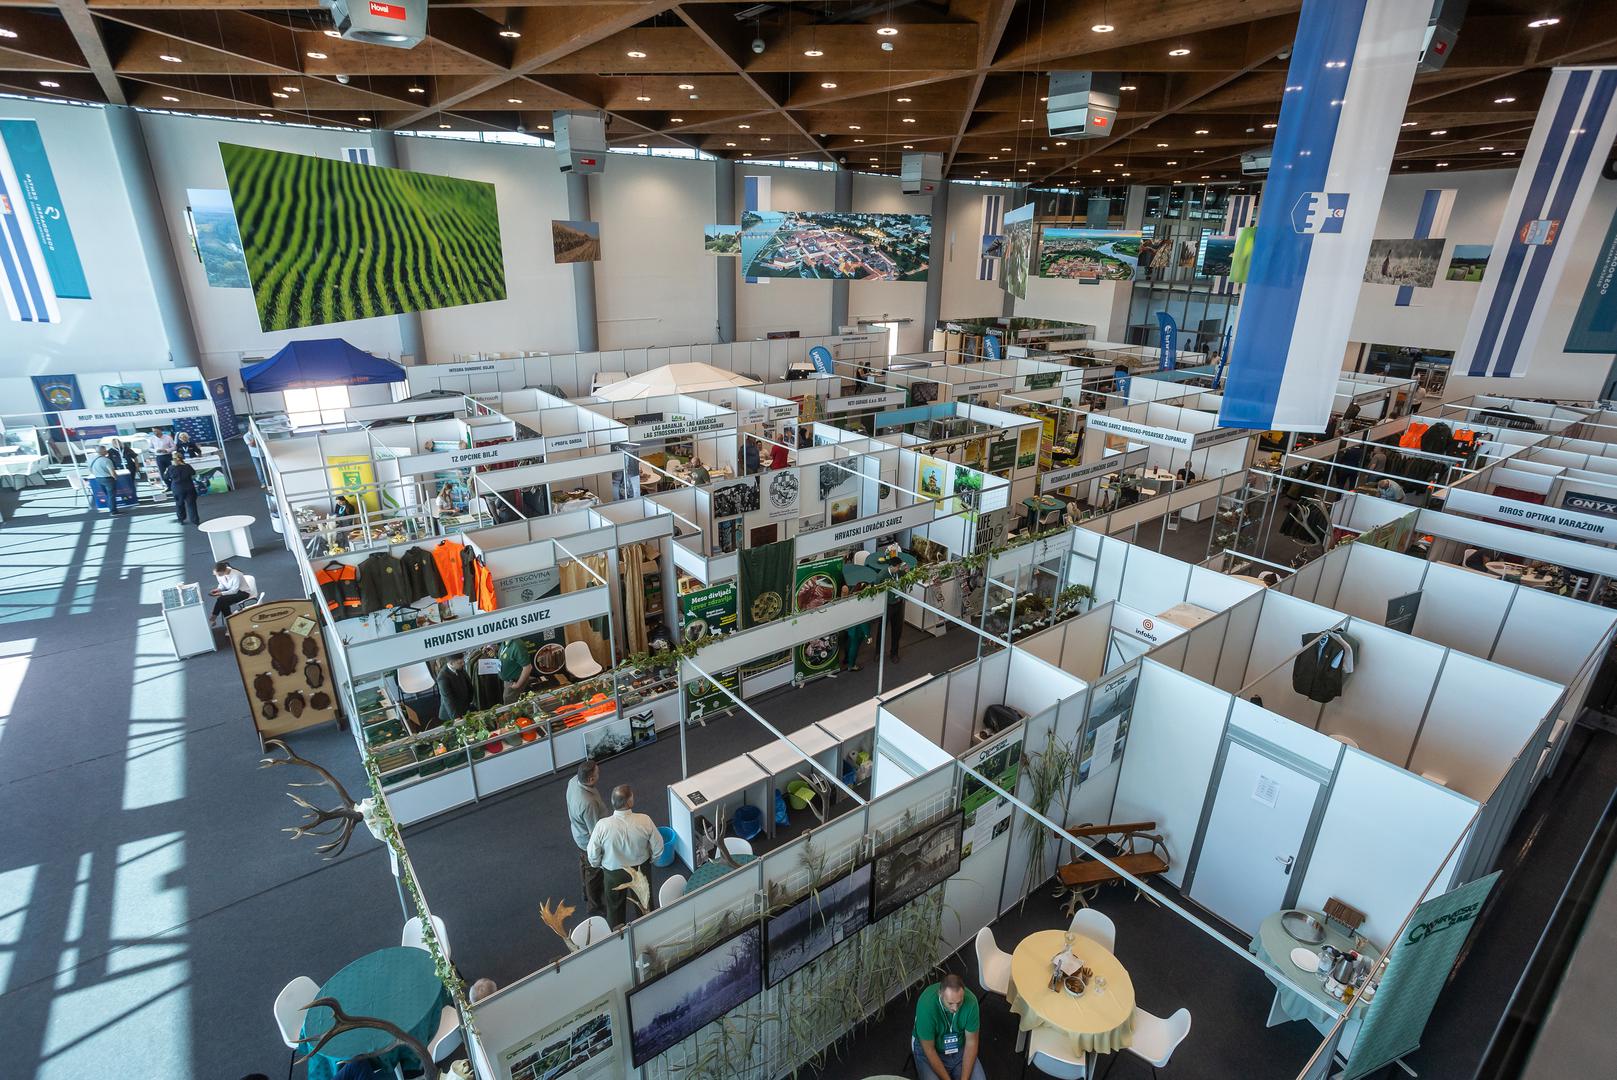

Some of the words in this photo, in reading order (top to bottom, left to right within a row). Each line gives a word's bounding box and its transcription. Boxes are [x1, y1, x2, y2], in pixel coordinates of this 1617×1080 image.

[370, 3, 389, 13] Hoval
[154, 407, 176, 415] CIVILNE
[452, 455, 460, 463] TZ
[482, 450, 498, 459] BILJE
[1572, 500, 1617, 513] ONYX
[977, 514, 992, 531] LIFE
[1498, 505, 1524, 517] BIROS
[1526, 511, 1556, 524] OPTIKA
[1558, 517, 1604, 534] VARAŽDIN
[834, 528, 862, 541] HRVATSKI
[862, 522, 885, 536] LOVAČKI
[886, 516, 903, 529] SAVEZ
[692, 596, 708, 604] Meso
[424, 628, 474, 649] HRVATSKI
[477, 616, 518, 636] LOVAČKI
[520, 609, 551, 625] SAVEZ
[1135, 628, 1158, 642] infobip
